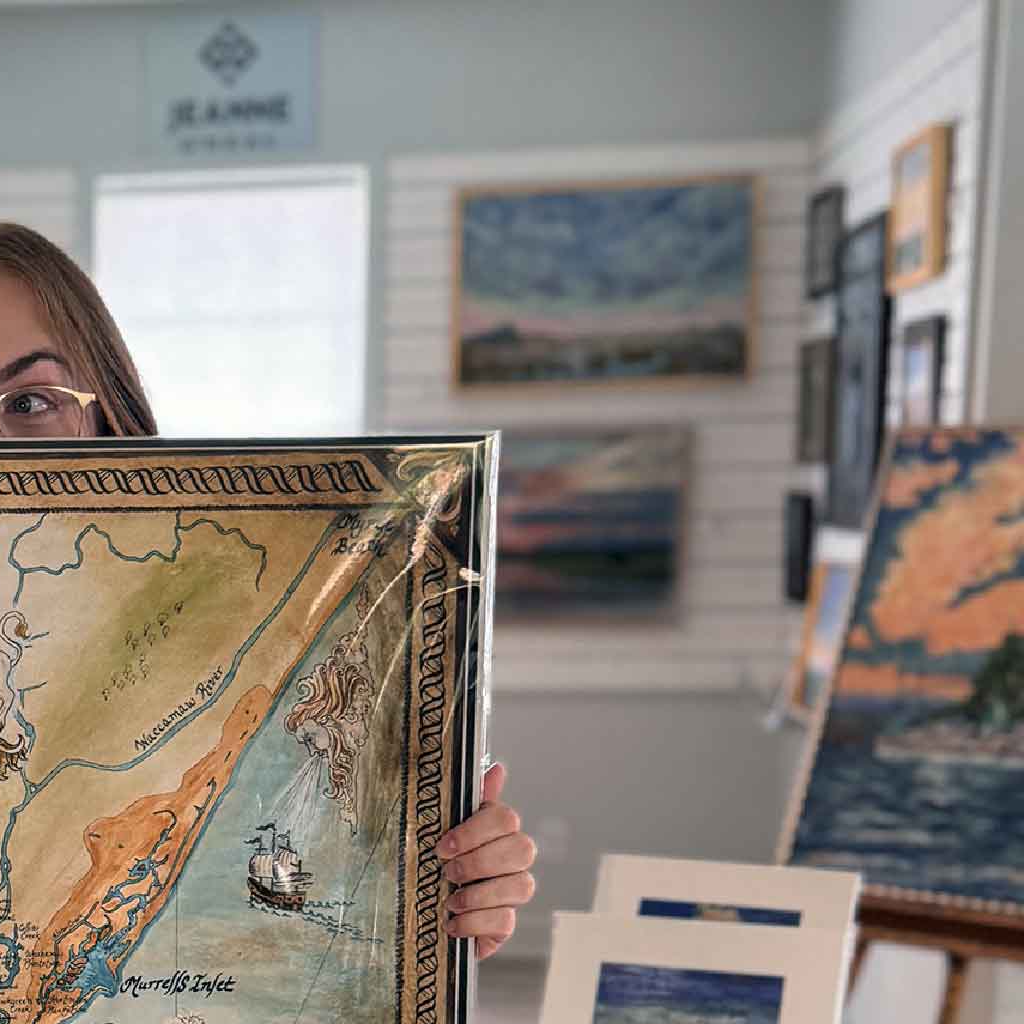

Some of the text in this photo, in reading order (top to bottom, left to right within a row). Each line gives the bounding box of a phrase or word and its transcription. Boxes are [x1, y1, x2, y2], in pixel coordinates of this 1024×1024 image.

[134, 665, 224, 752] Waccamaw River
[120, 970, 237, 998] Murrells Inlet
